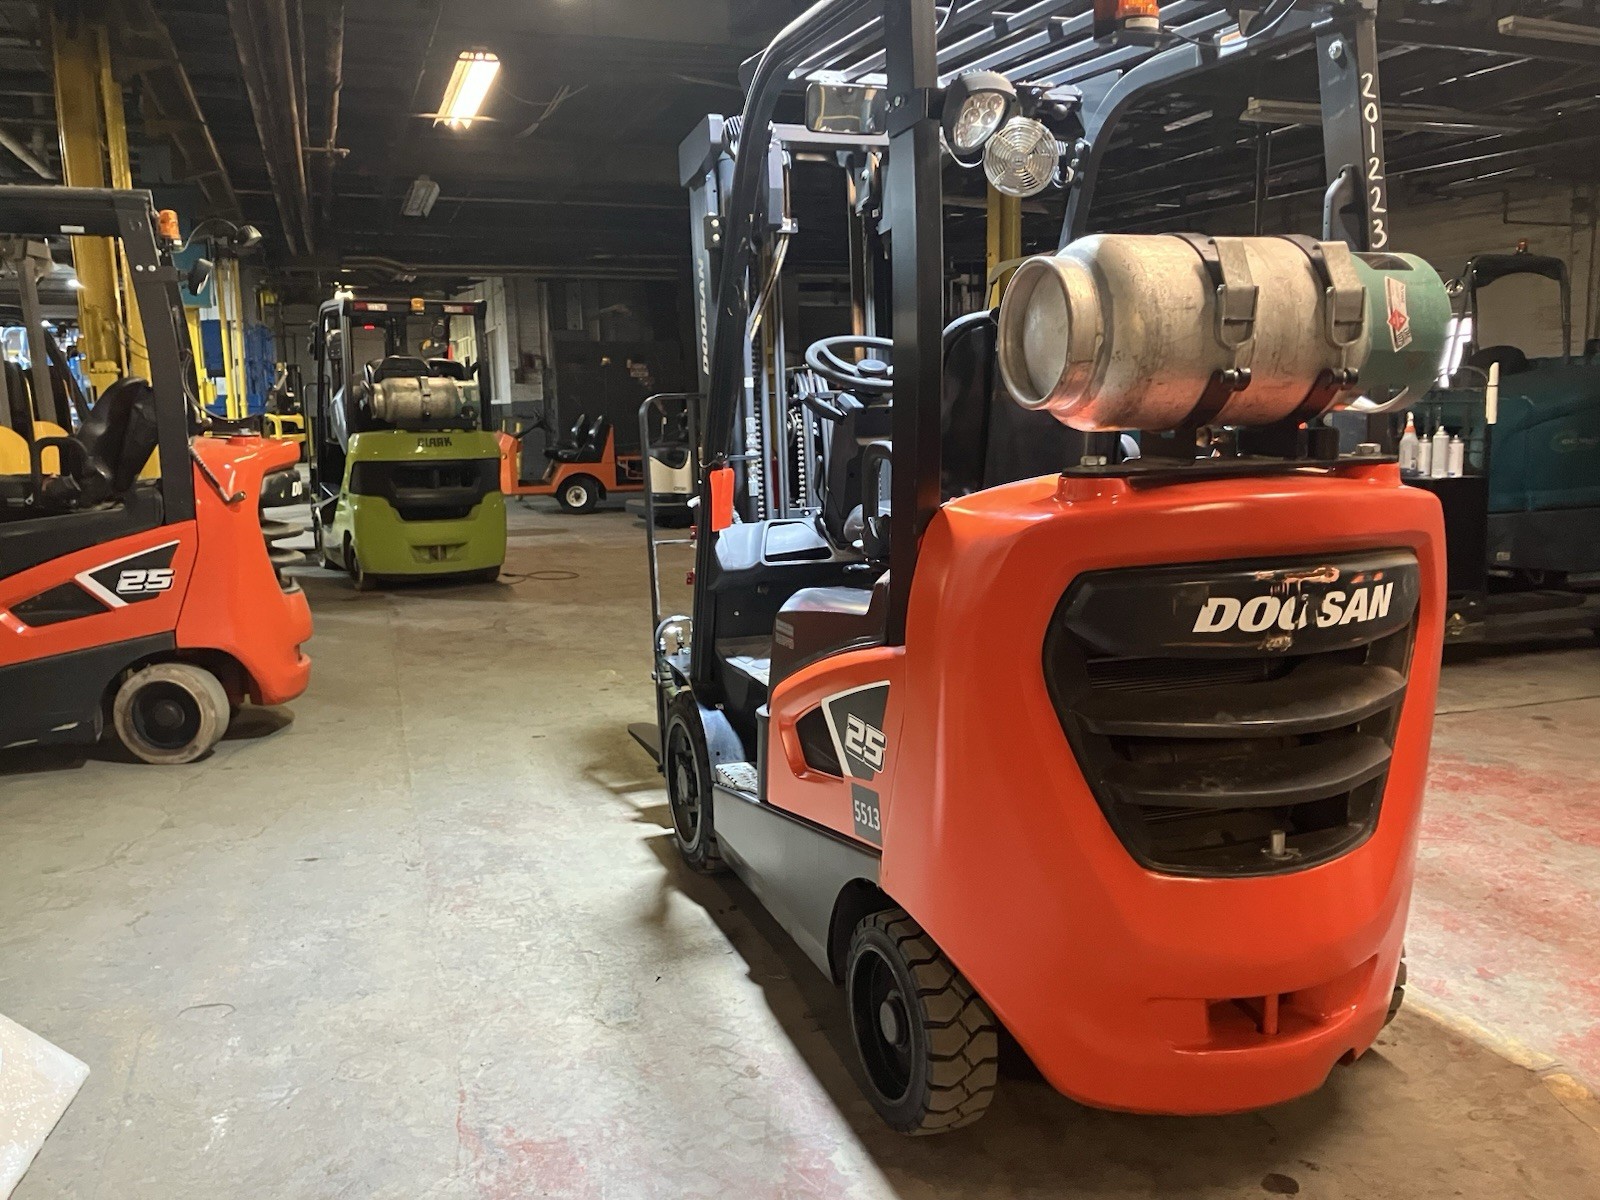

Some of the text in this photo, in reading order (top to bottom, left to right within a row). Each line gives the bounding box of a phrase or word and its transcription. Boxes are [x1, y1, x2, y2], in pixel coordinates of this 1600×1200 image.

[1360, 72, 1387, 248] 201223
[697, 258, 709, 375] DOOSAN
[417, 437, 452, 447] CLARK
[116, 568, 175, 594] 25
[845, 713, 887, 773] 25
[853, 799, 881, 831] 5513
